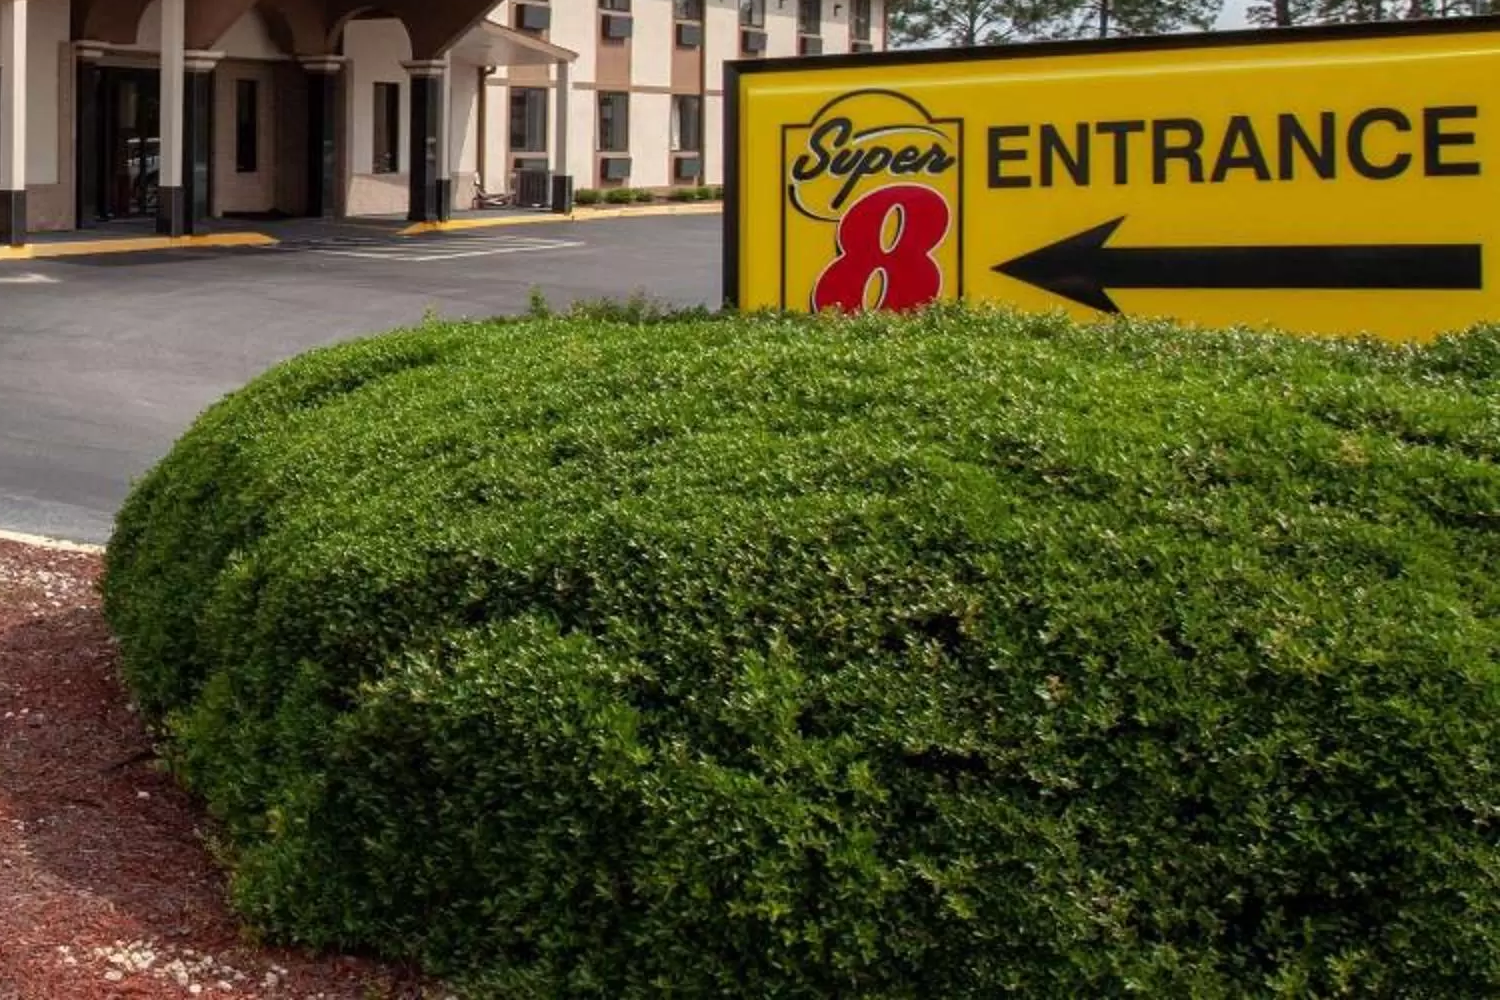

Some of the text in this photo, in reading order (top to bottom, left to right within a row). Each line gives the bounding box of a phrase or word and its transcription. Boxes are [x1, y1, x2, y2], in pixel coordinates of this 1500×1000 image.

[791, 117, 955, 209] Super
[987, 106, 1481, 188] ENTRANCE
[812, 183, 951, 315] 8
